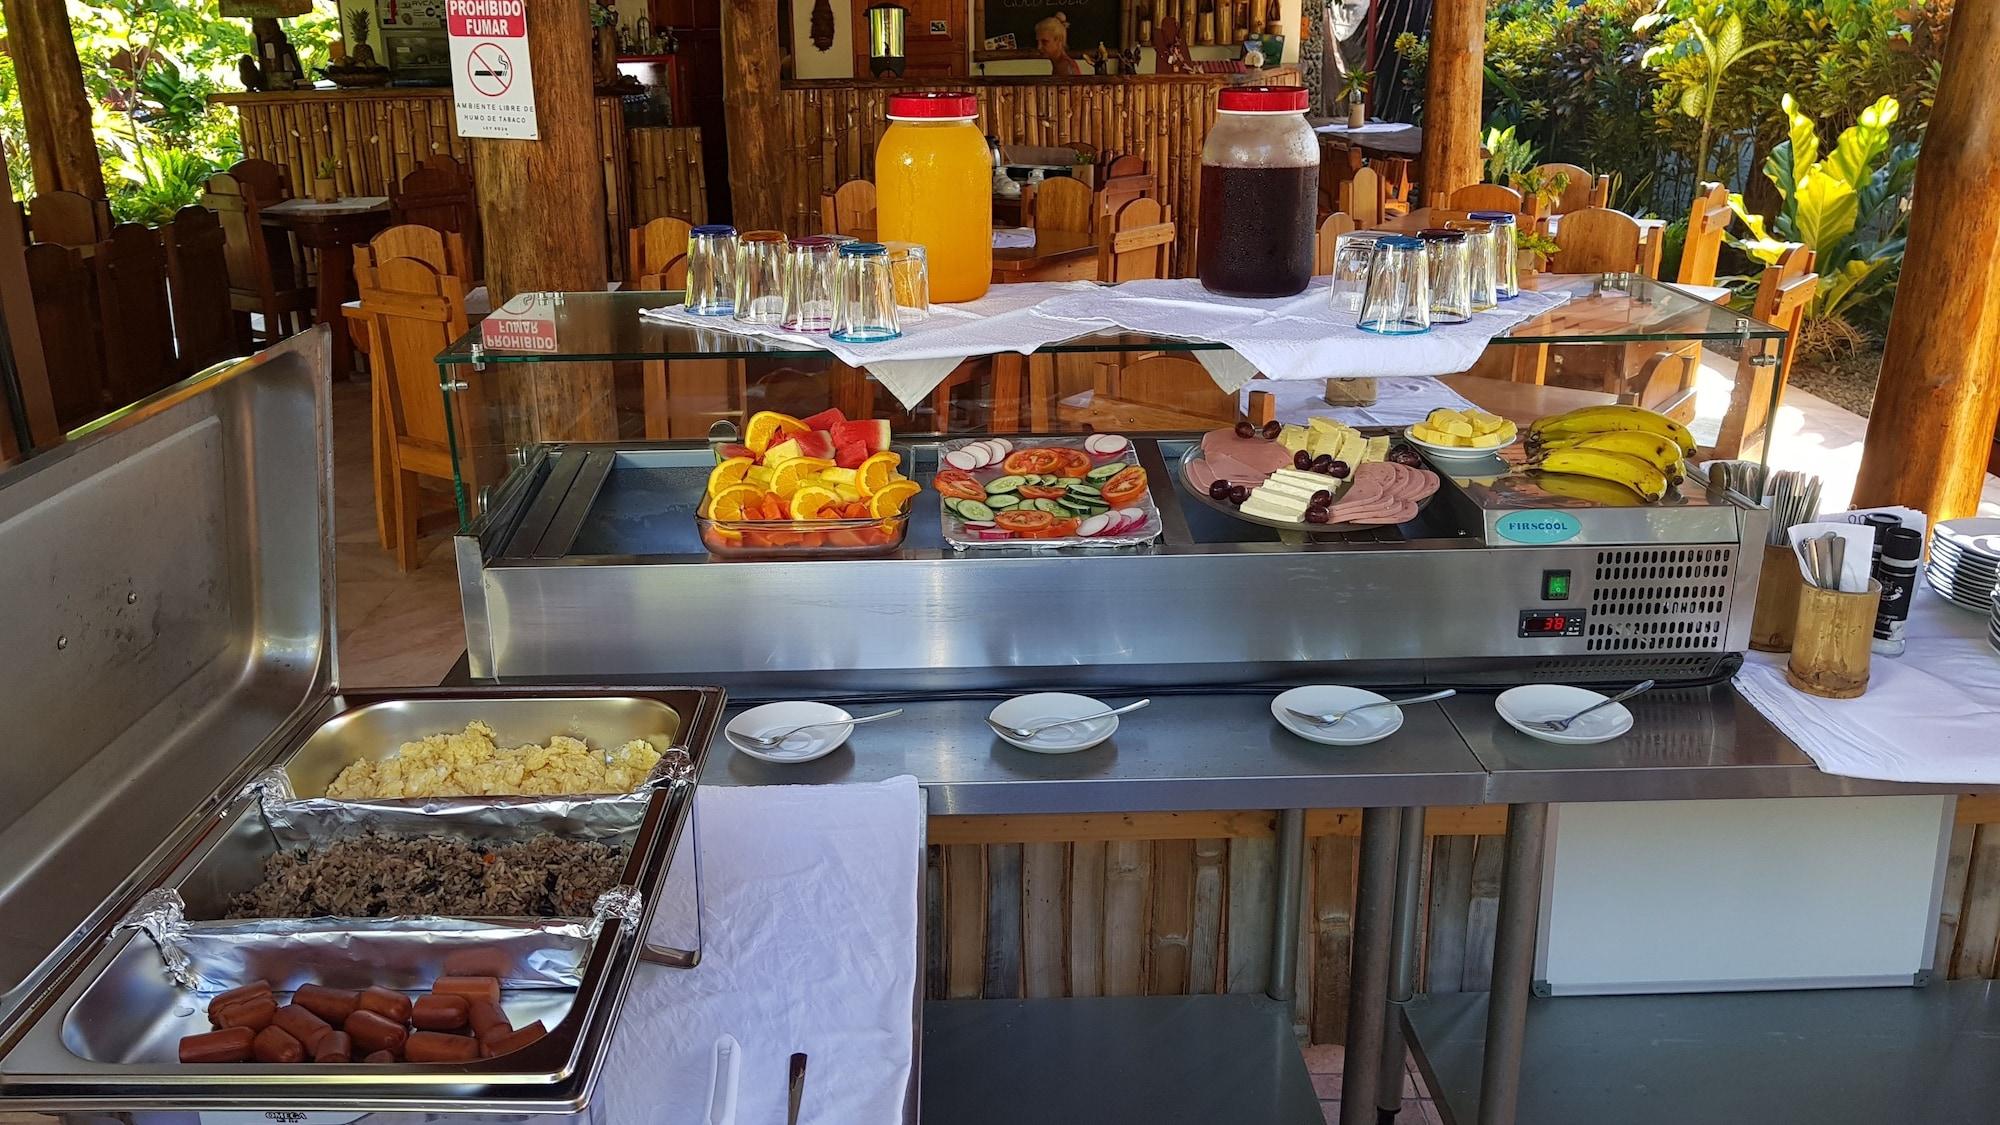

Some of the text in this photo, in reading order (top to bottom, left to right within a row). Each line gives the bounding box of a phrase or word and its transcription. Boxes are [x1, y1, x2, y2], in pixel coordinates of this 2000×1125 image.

[450, 0, 521, 16] PROHIBIDO
[466, 19, 508, 35] FUMAR
[1509, 522, 1568, 530] FIRSCOOL
[1544, 617, 1564, 630] 38
